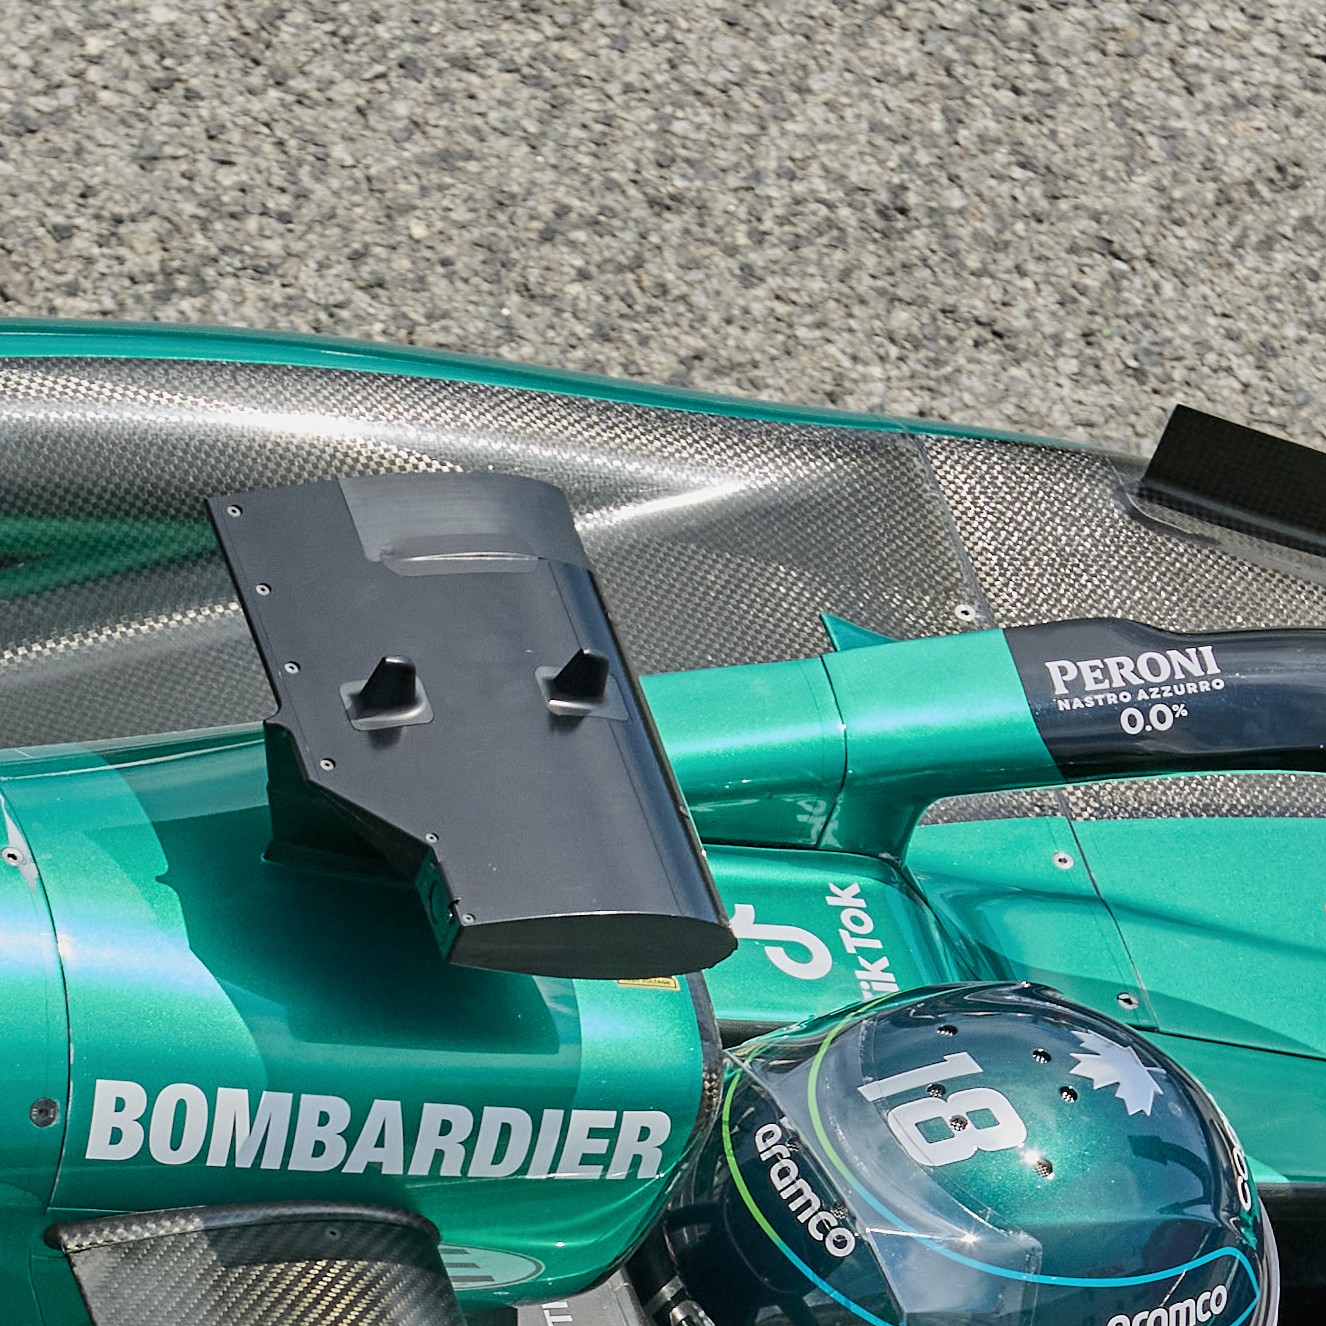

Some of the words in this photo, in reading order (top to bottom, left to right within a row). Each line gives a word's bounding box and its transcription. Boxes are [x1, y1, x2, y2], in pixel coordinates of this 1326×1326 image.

[1045, 645, 1221, 696] PERONI
[1053, 691, 1132, 711] NASTRO
[1137, 677, 1225, 702] AZZURRO
[1120, 702, 1188, 735] 0.0%
[84, 1079, 672, 1181] BOMBARDIER
[857, 1051, 1029, 1168] 18
[754, 1121, 857, 1258] aramco
